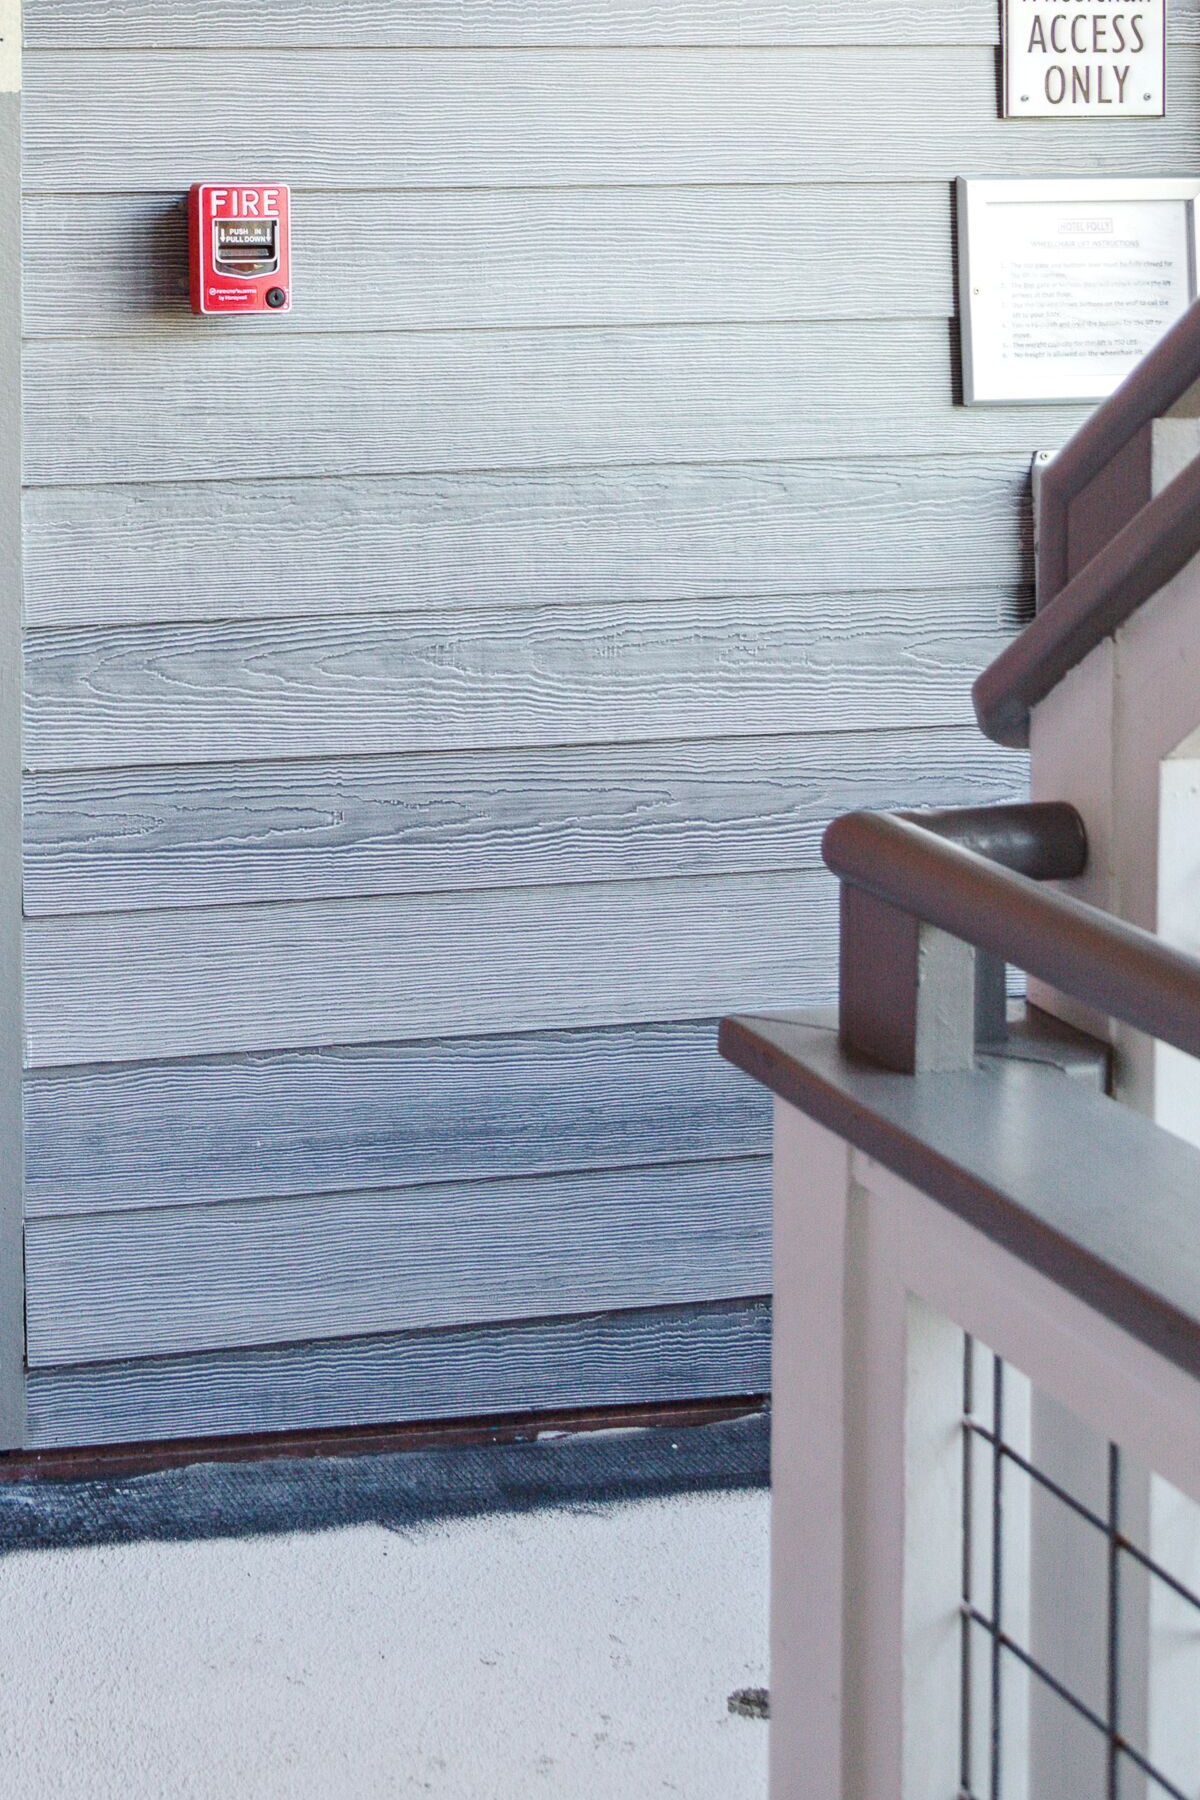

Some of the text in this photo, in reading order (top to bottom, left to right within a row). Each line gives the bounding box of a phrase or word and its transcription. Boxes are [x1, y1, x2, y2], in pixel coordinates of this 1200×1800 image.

[1027, 14, 1144, 54] ACCESS
[1044, 65, 1130, 104] ONLY
[210, 189, 280, 216] FIRE
[225, 235, 266, 243] PULL DOWN
[1060, 221, 1084, 231] HOTEL
